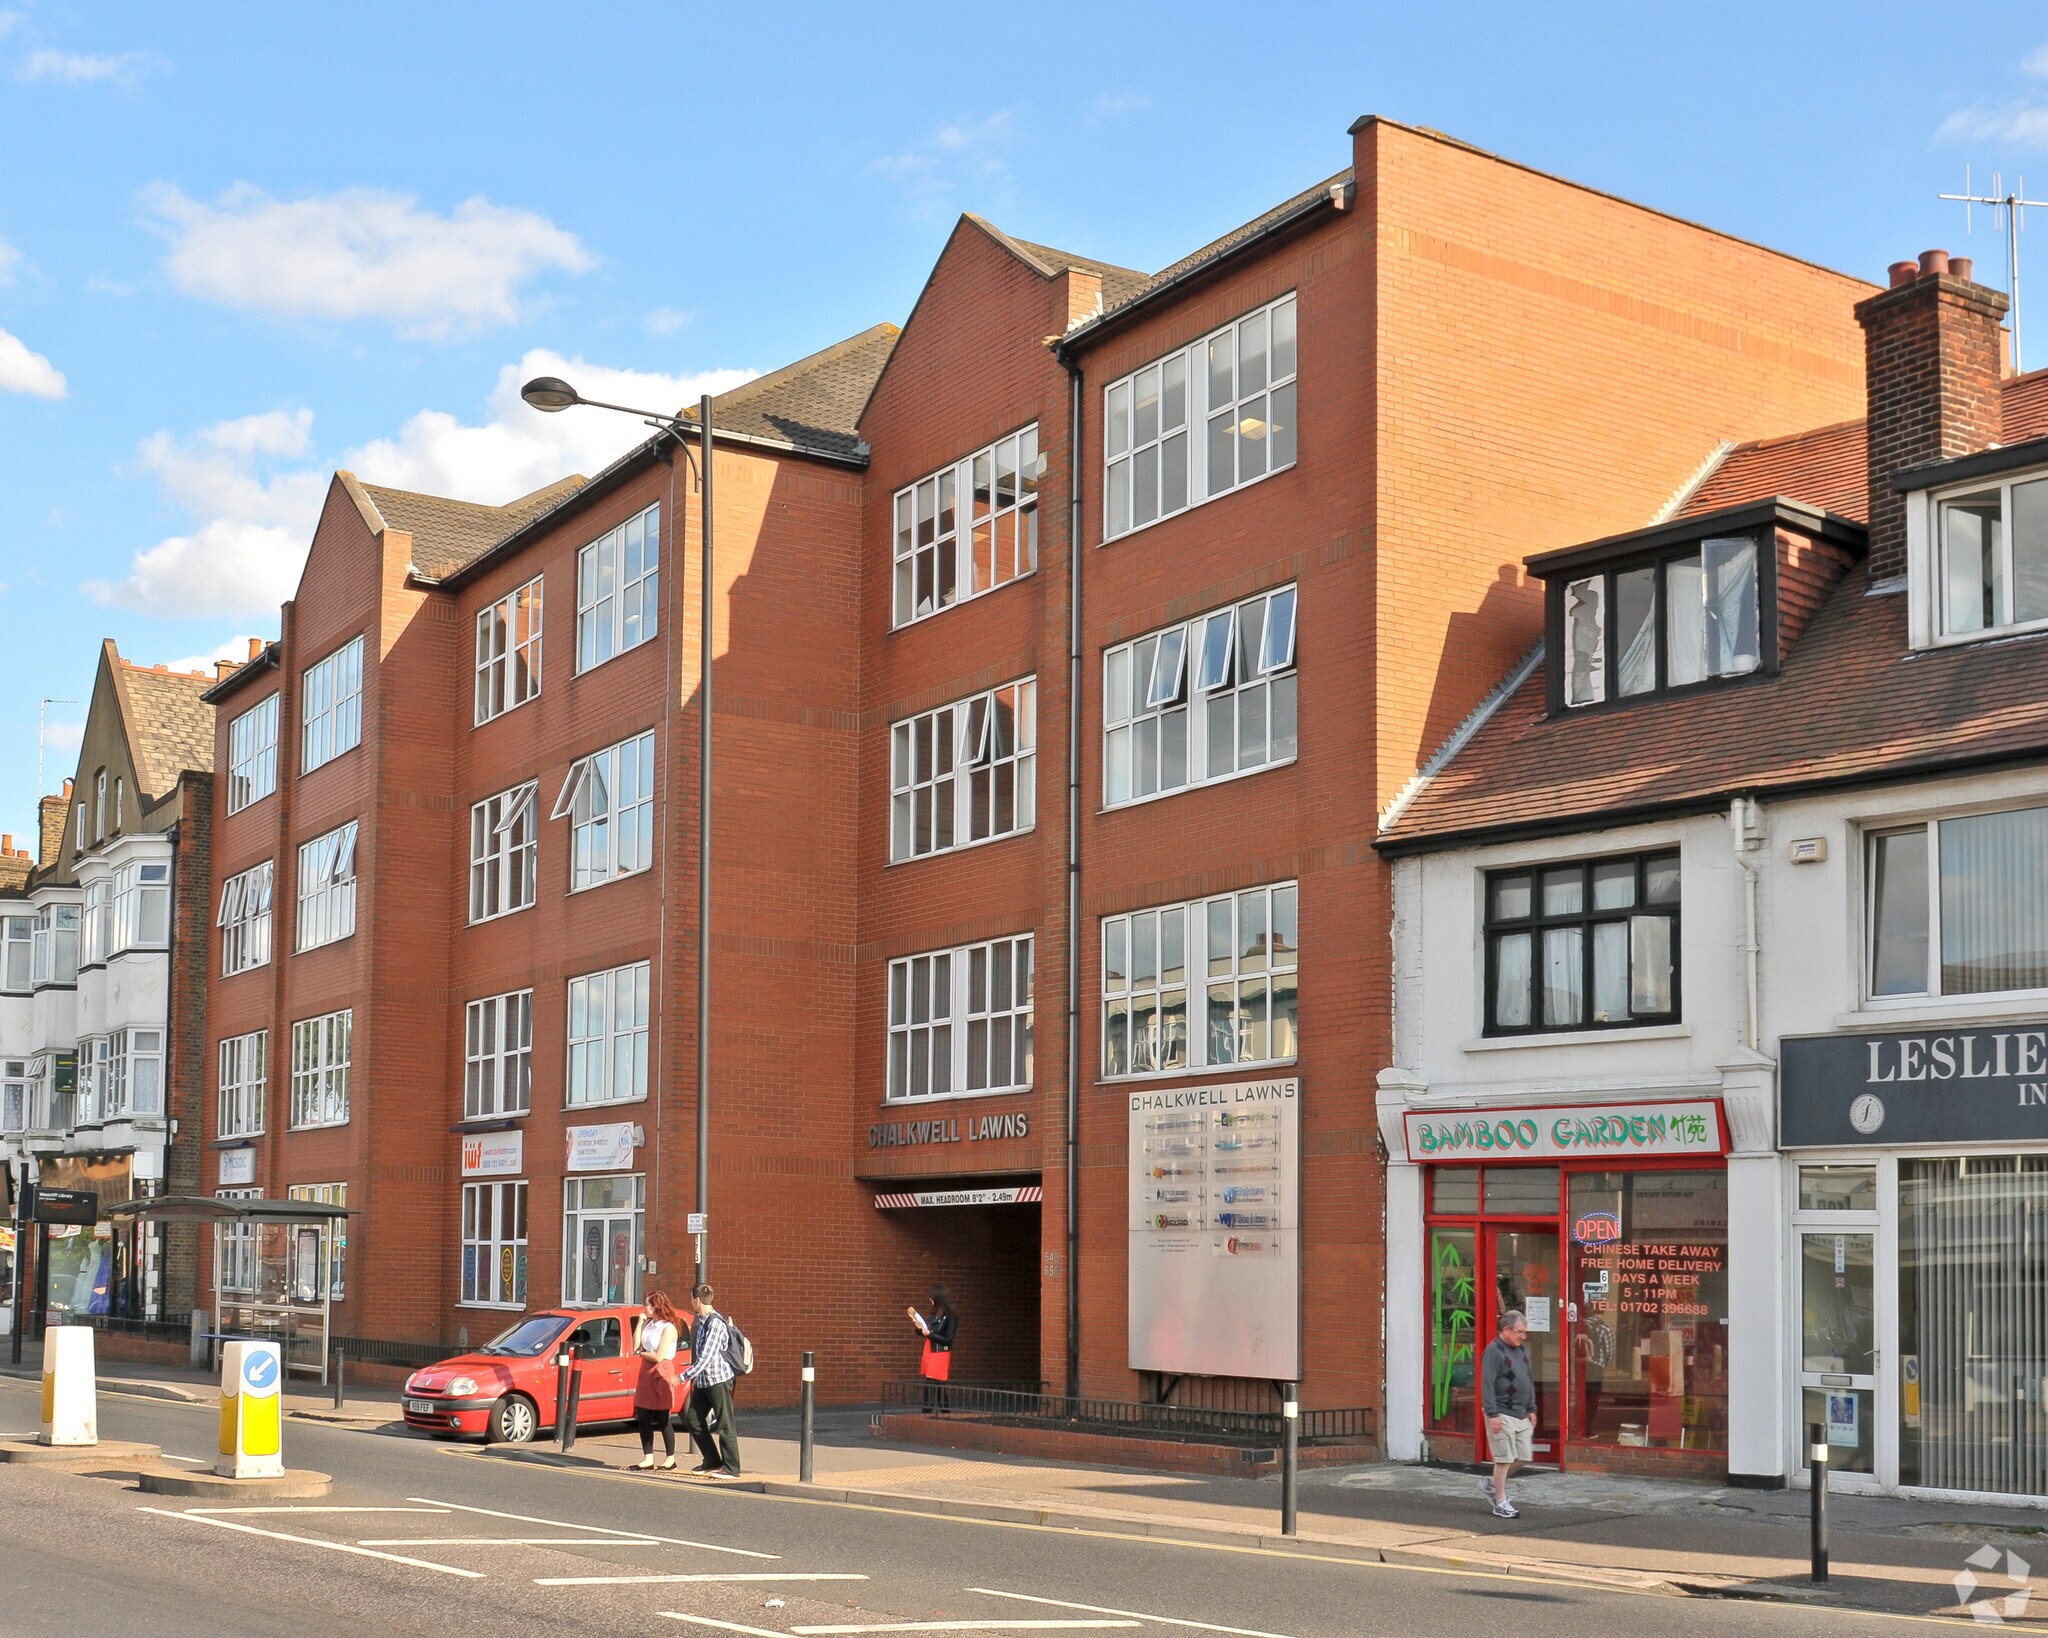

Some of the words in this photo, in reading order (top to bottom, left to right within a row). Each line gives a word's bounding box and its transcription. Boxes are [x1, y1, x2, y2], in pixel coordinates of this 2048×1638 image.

[1866, 1032, 2047, 1083] LESLIE
[1131, 1090, 1228, 1111] CHALKWELL
[1235, 1083, 1295, 1102] LAWNS
[867, 1119, 961, 1148] CHALKWELL
[968, 1113, 1028, 1140] LAWNS
[1418, 1118, 1538, 1154] BAMBOO
[1551, 1114, 1667, 1150] GARDEN
[920, 1195, 936, 1205] MAX.
[936, 1194, 970, 1204] HEADROOM
[992, 1192, 1013, 1202] 2.49m
[1575, 1219, 1619, 1240] OPEN
[1584, 1244, 1640, 1255] CHINESE
[1643, 1245, 1677, 1255] TAKE
[1680, 1246, 1719, 1257] AWAY
[1581, 1258, 1612, 1269] FREE
[1617, 1259, 1654, 1270] HOME
[1658, 1260, 1722, 1272] DELIVERY
[1602, 1272, 1607, 1282] 6
[1612, 1273, 1646, 1284] DAYS
[1649, 1274, 1658, 1284] A
[1662, 1274, 1700, 1285] WEEK
[1584, 1283, 1607, 1292] Hungry?
[1623, 1287, 1631, 1298] 5
[1643, 1288, 1677, 1299] 11PM
[1591, 1301, 1617, 1311] TEL:
[1620, 1302, 1658, 1313] 01702
[1661, 1303, 1709, 1315] 396688
